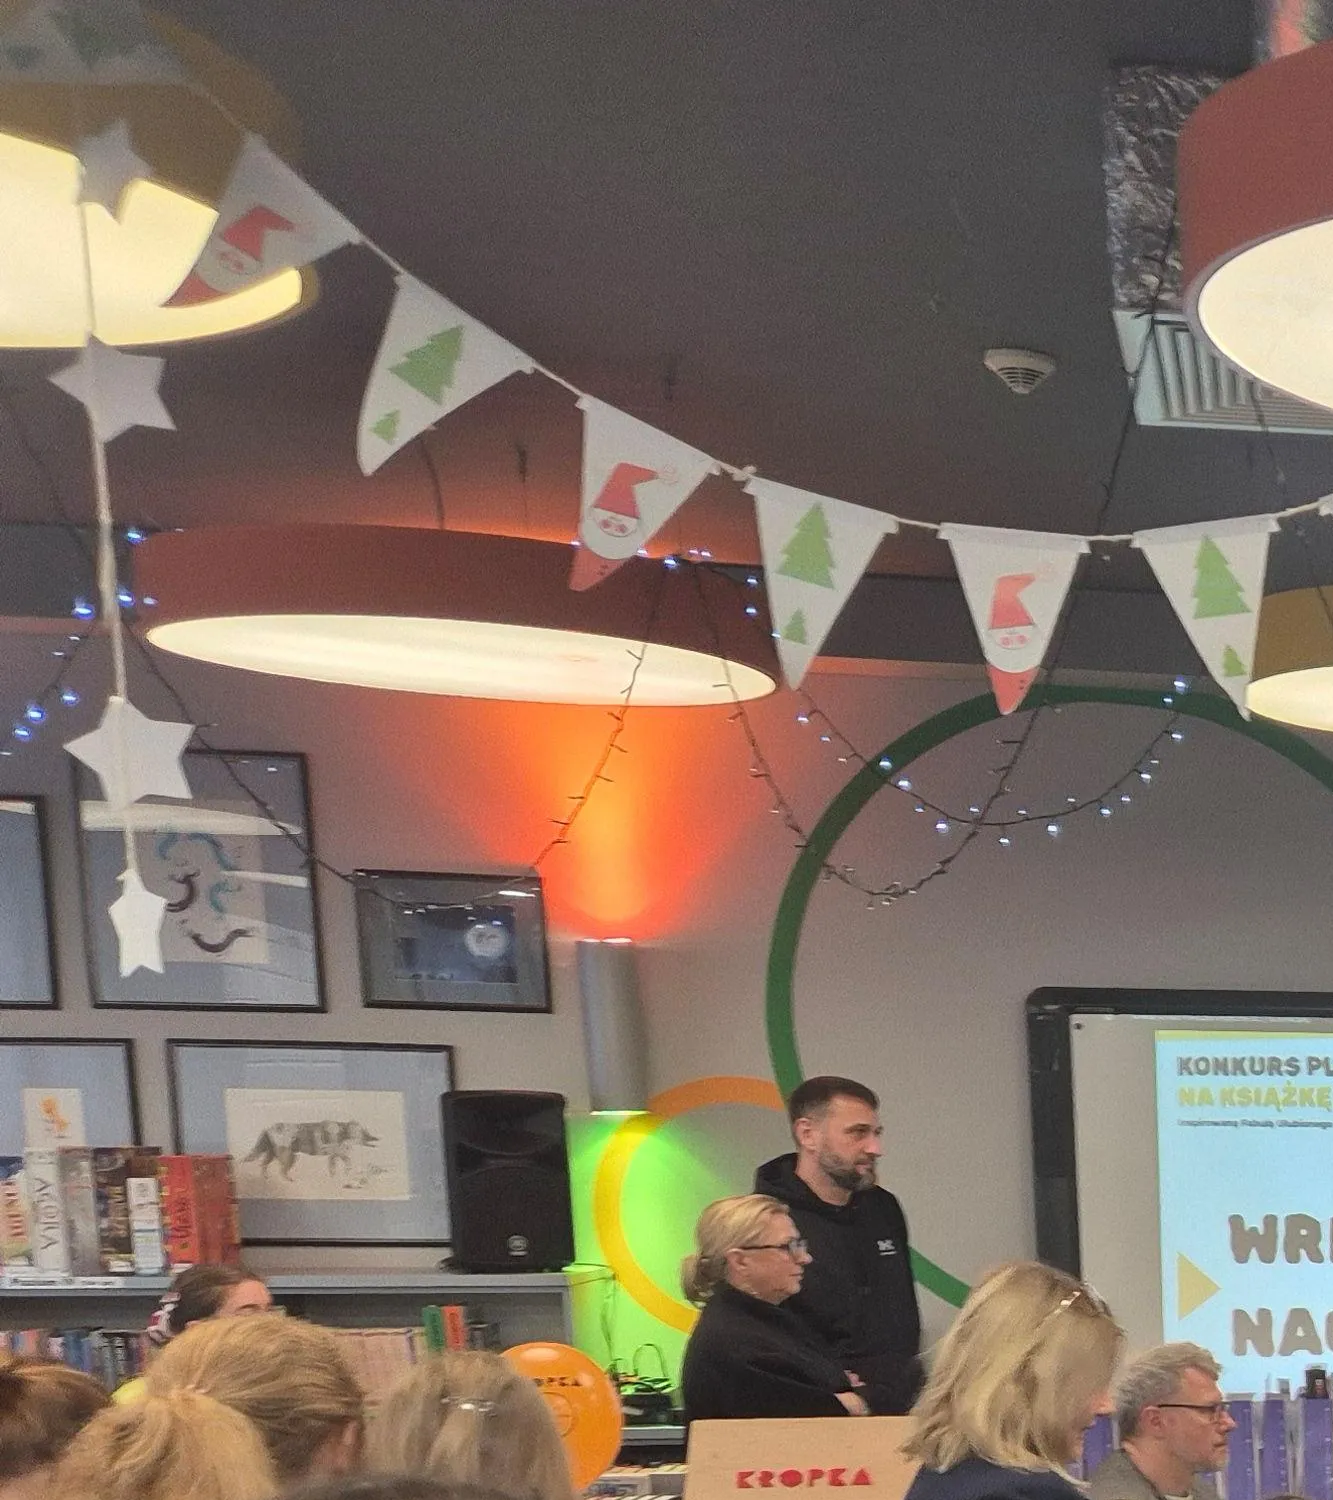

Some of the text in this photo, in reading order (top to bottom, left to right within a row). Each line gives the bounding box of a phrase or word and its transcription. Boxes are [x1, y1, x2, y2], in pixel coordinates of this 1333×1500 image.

[1178, 1056, 1300, 1077] KONKURS
[1178, 1086, 1212, 1107] NA
[1218, 1081, 1332, 1112] KSIĄŻKĘ
[736, 1467, 873, 1489] KROPKA
